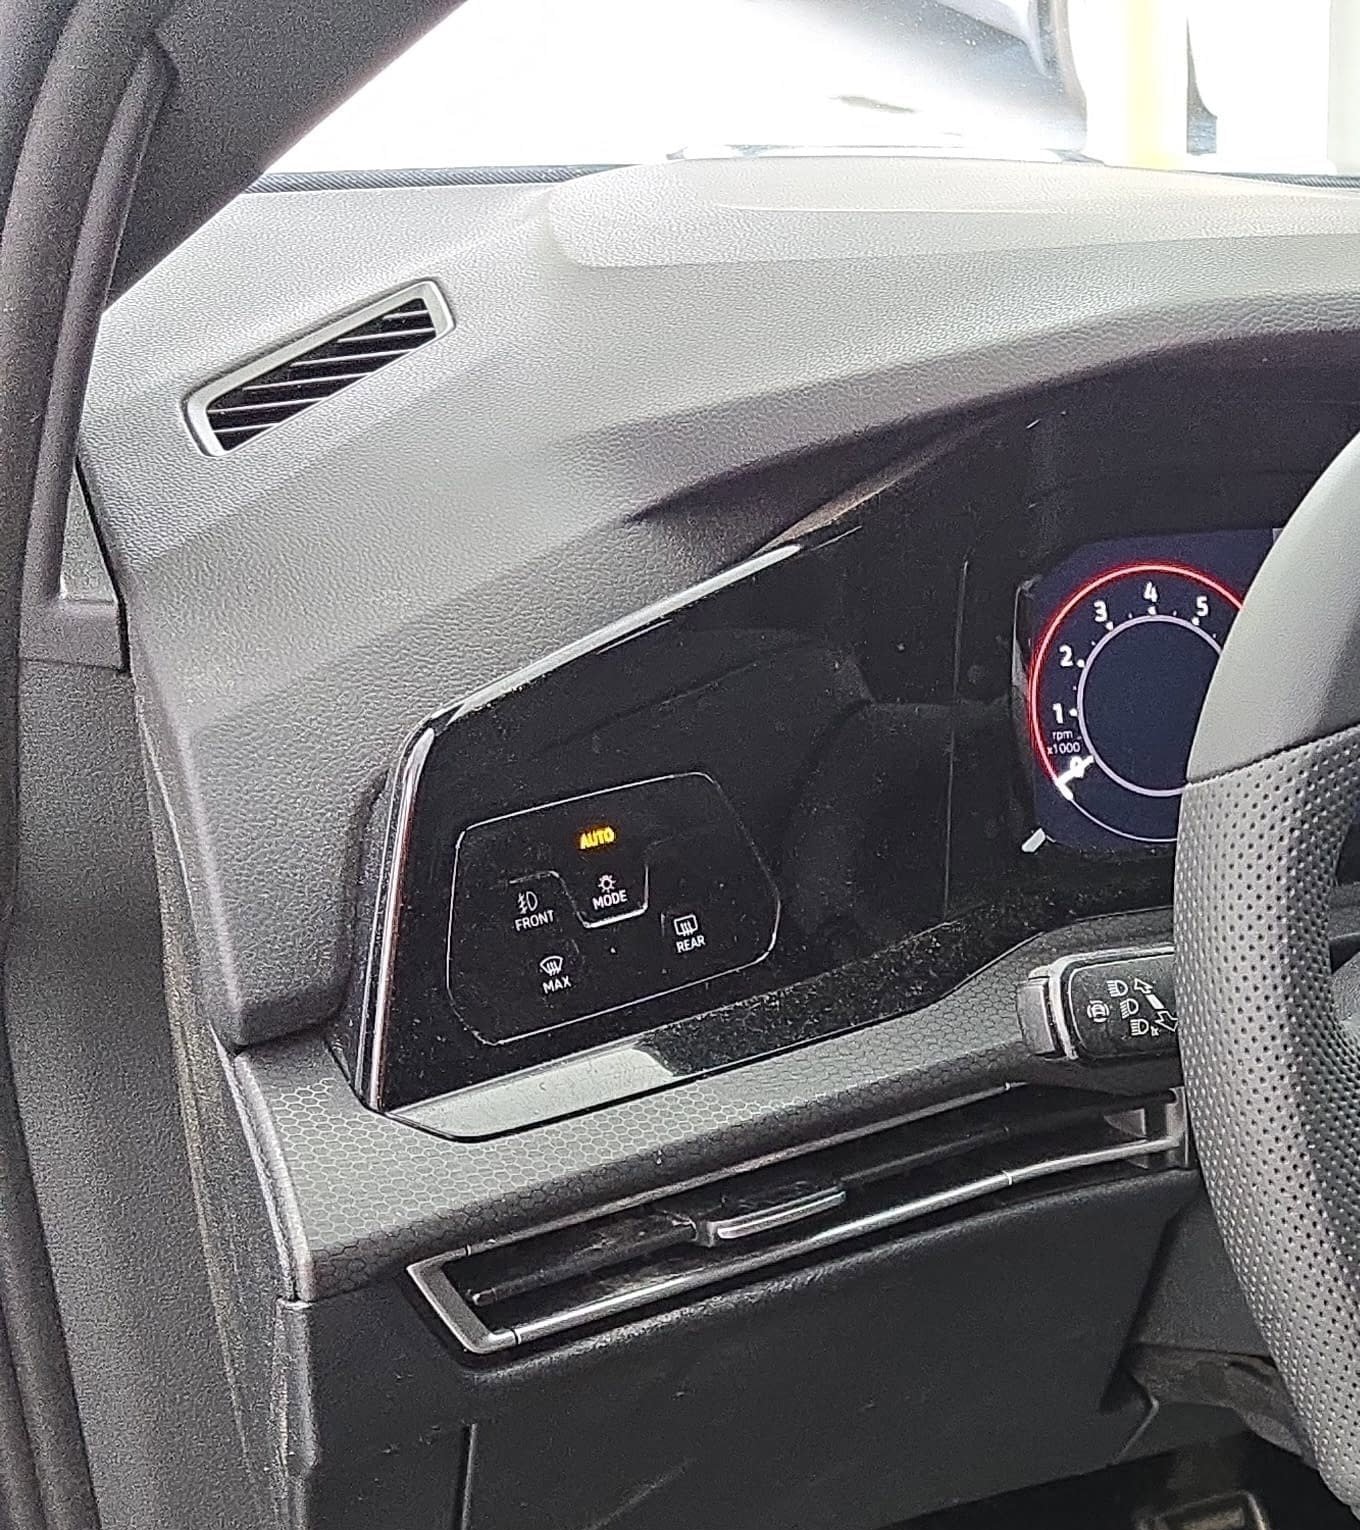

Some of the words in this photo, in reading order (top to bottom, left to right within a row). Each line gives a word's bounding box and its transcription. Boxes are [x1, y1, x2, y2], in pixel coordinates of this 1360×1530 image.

[1144, 582, 1157, 602] 4
[1094, 600, 1107, 622] 3
[1197, 596, 1208, 617] 5
[1059, 645, 1073, 667] 2
[1053, 703, 1064, 724] 1
[1052, 730, 1073, 741] rpm
[1047, 741, 1080, 754] x1000
[580, 826, 615, 850] AUTO
[592, 889, 628, 910] MODE
[515, 910, 555, 931] FRONT
[676, 935, 706, 953] REAR
[542, 976, 572, 995] MAX
